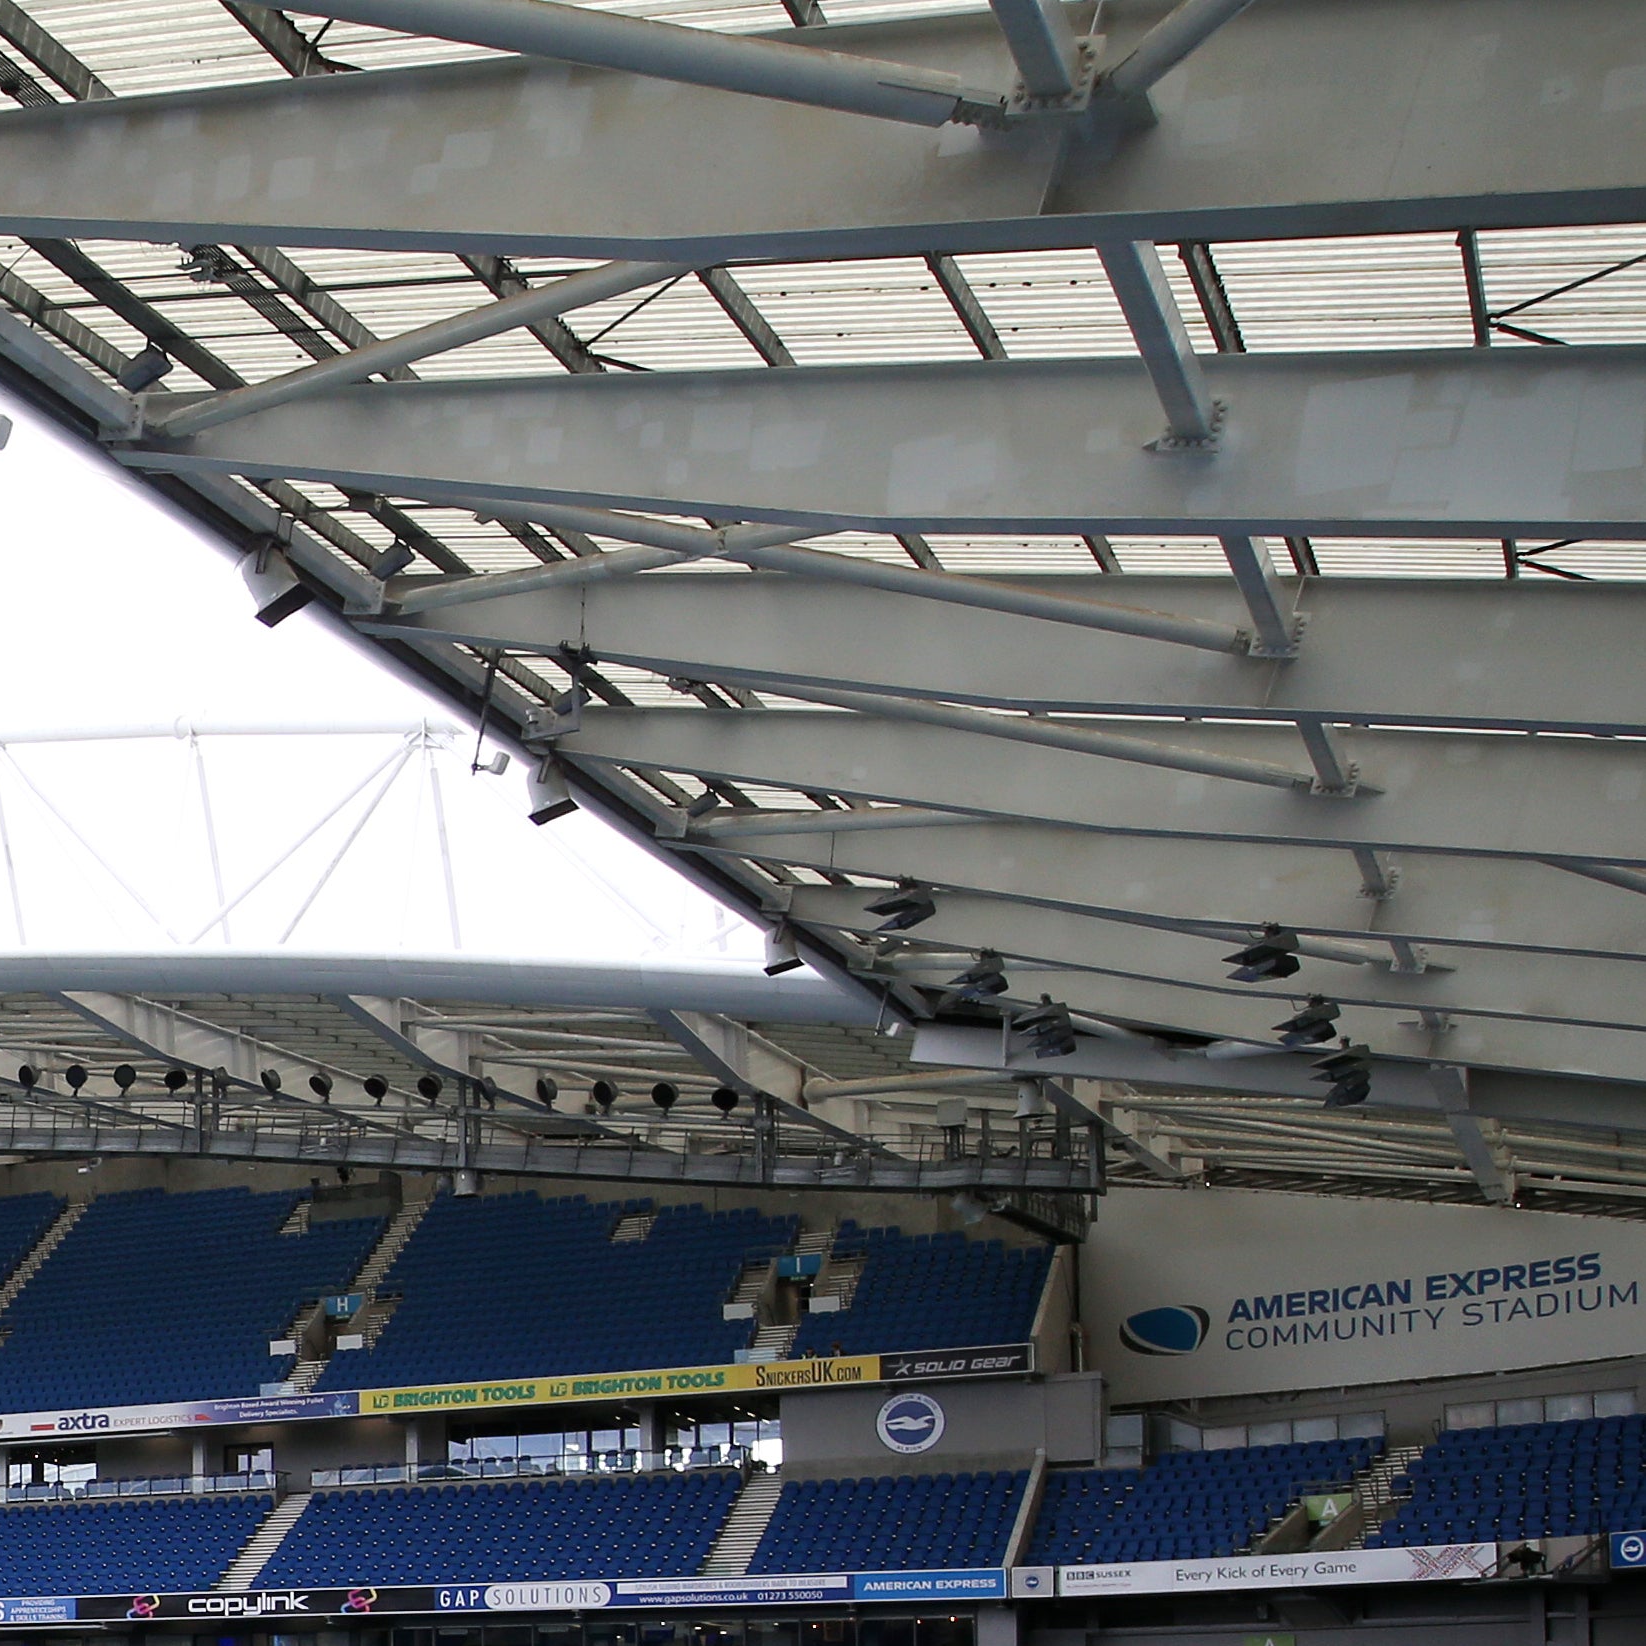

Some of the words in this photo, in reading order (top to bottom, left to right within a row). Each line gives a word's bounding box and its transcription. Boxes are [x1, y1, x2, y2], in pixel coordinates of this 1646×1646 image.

[1227, 1279, 1411, 1325] AMERICAN
[1425, 1252, 1602, 1301] EXPRESS
[337, 1298, 348, 1312] H
[1225, 1304, 1446, 1351] COMMUNITY
[1462, 1281, 1639, 1327] STADIUM
[914, 1358, 965, 1374] SOLID
[572, 1376, 662, 1394] BRIGHTON
[666, 1372, 725, 1389] TOOLS
[393, 1390, 476, 1408] BRIGHTON
[481, 1385, 536, 1401] TOOLS
[58, 1412, 109, 1431] axtra
[113, 1418, 146, 1428] EXPERT
[148, 1414, 193, 1426] LOGISTICS
[1320, 1499, 1338, 1518] A
[1066, 1570, 1095, 1581] BBC
[1096, 1568, 1132, 1580] SUSSEX
[1175, 1568, 1213, 1587] Every
[1217, 1564, 1247, 1580] Kick
[1250, 1564, 1266, 1578] of
[1269, 1564, 1308, 1582] Every
[1314, 1560, 1357, 1576] Game
[863, 1579, 932, 1592] AMERICAN
[936, 1577, 997, 1590] EXPRESS
[188, 1592, 309, 1616] copylink
[440, 1590, 480, 1607] GAP
[492, 1586, 602, 1606] SOLUTIONS
[639, 1591, 749, 1606] www.gapsolutions.co.uk
[757, 1591, 787, 1601] 01273
[788, 1589, 823, 1600] 550050
